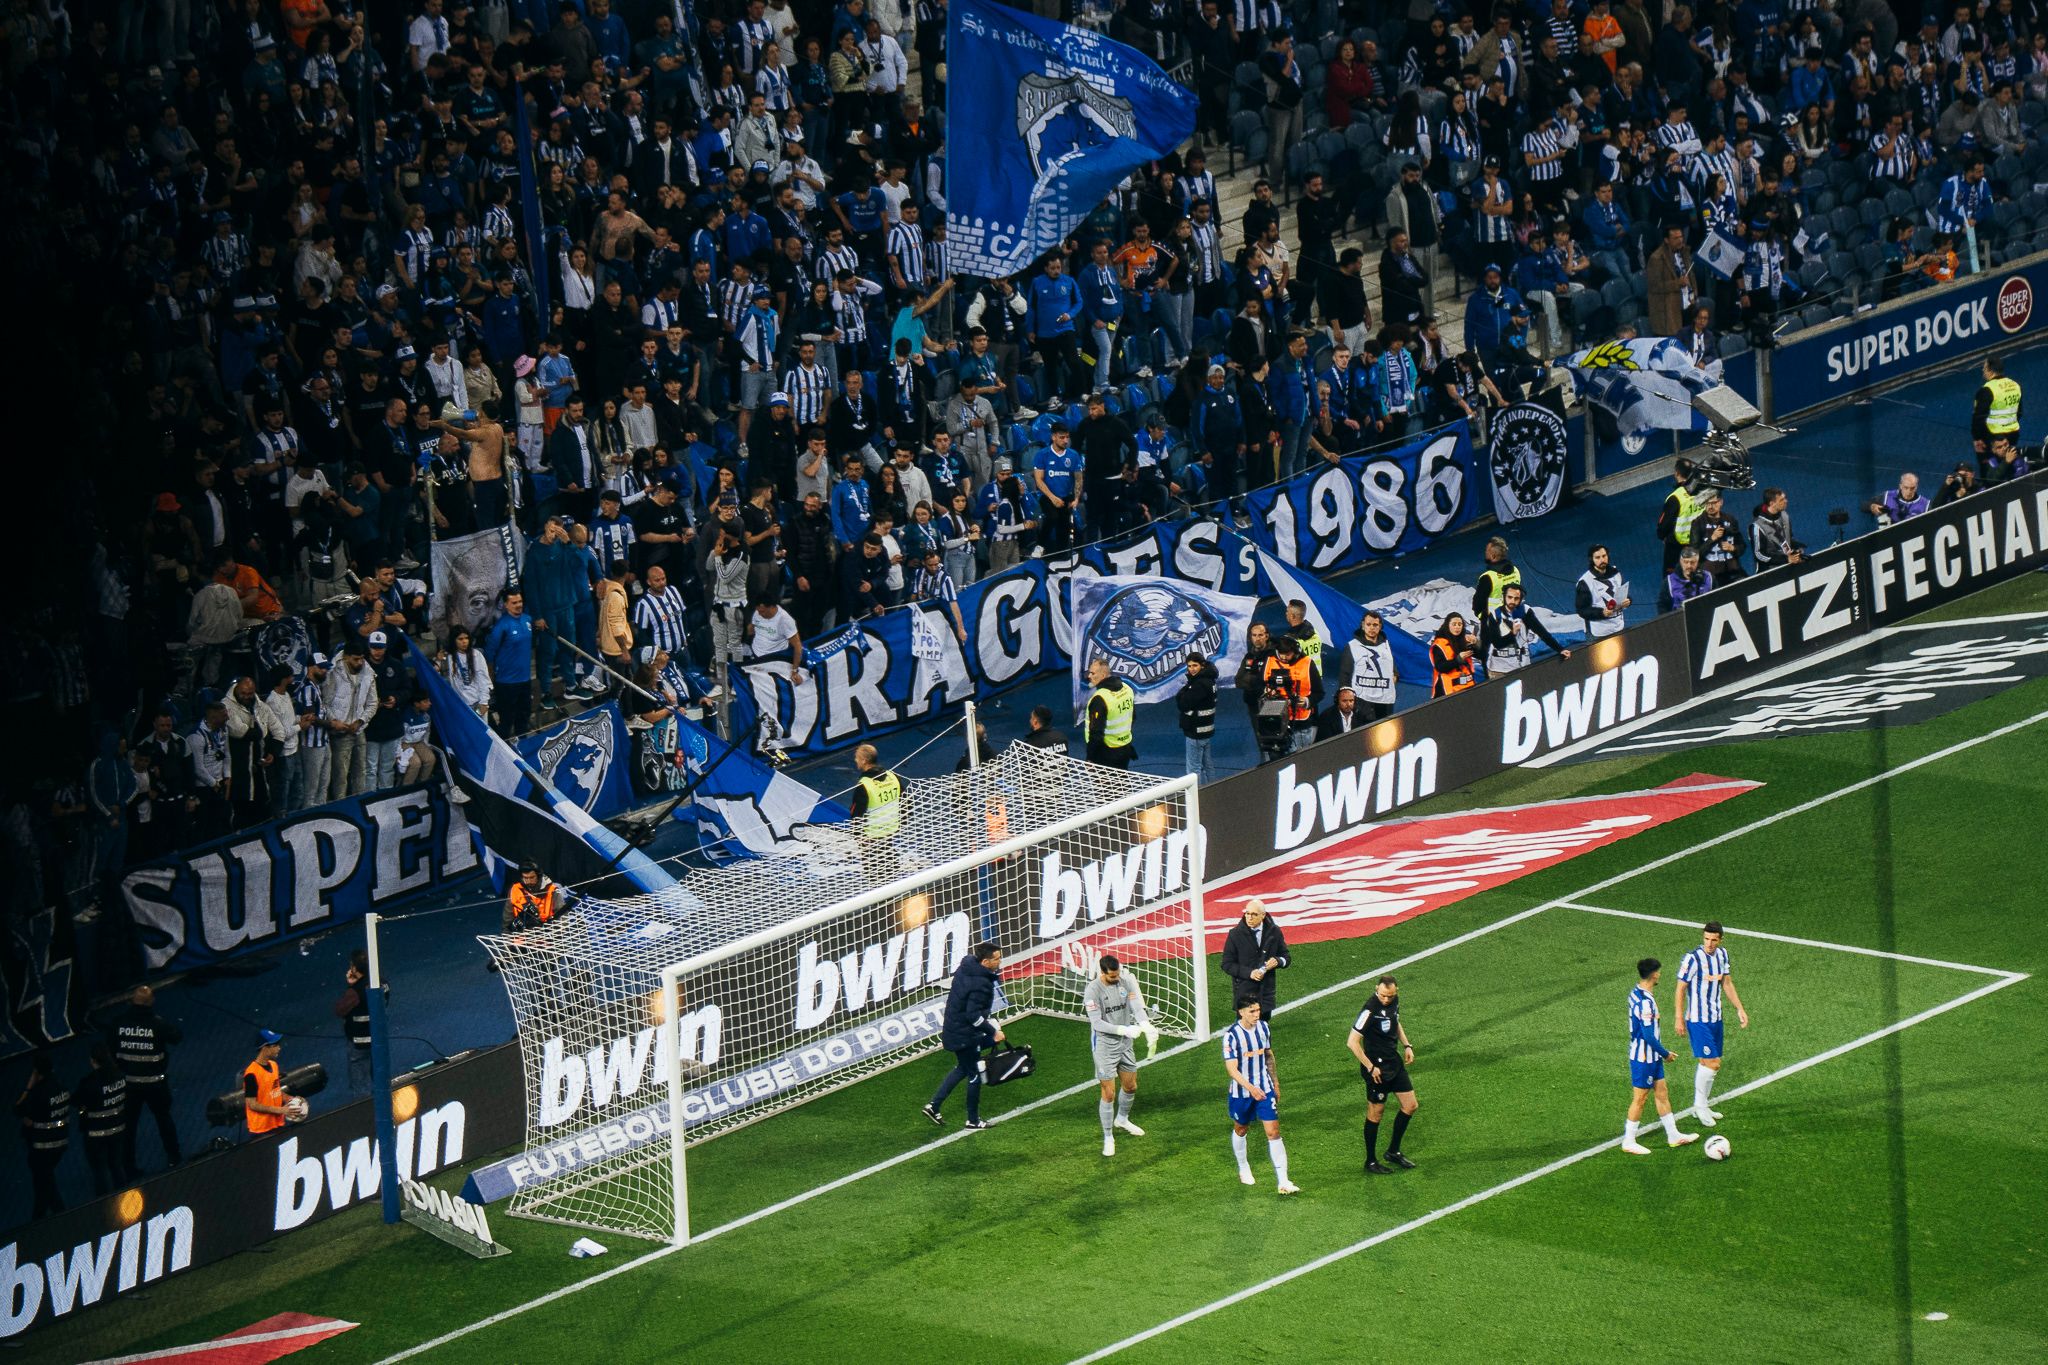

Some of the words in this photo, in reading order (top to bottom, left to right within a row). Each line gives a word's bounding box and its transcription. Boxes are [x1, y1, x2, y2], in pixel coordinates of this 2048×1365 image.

[1828, 324, 1910, 382] SUPER
[1915, 296, 1990, 353] BOCK
[2001, 289, 2028, 308] SUPER
[2002, 302, 2028, 320] BOCK
[1266, 436, 1463, 568] 1986
[1871, 488, 2048, 614] FECHA
[1701, 560, 1852, 679] ATZ
[1849, 557, 1859, 601] GROUP
[1502, 640, 1659, 764] bwin
[878, 787, 898, 803] 1317
[1275, 724, 1438, 850] bwin
[1039, 808, 1208, 938] bwin
[795, 896, 970, 1030] bwin
[118, 1025, 154, 1038] POLÍCIA
[507, 1108, 672, 1187] FUTEBOL
[682, 1059, 796, 1121] CLUBE
[802, 1038, 853, 1074] DO
[855, 1002, 947, 1055] PORT
[539, 992, 722, 1127] bwin
[274, 1087, 467, 1231] bwin
[0, 1191, 195, 1338] bwin
